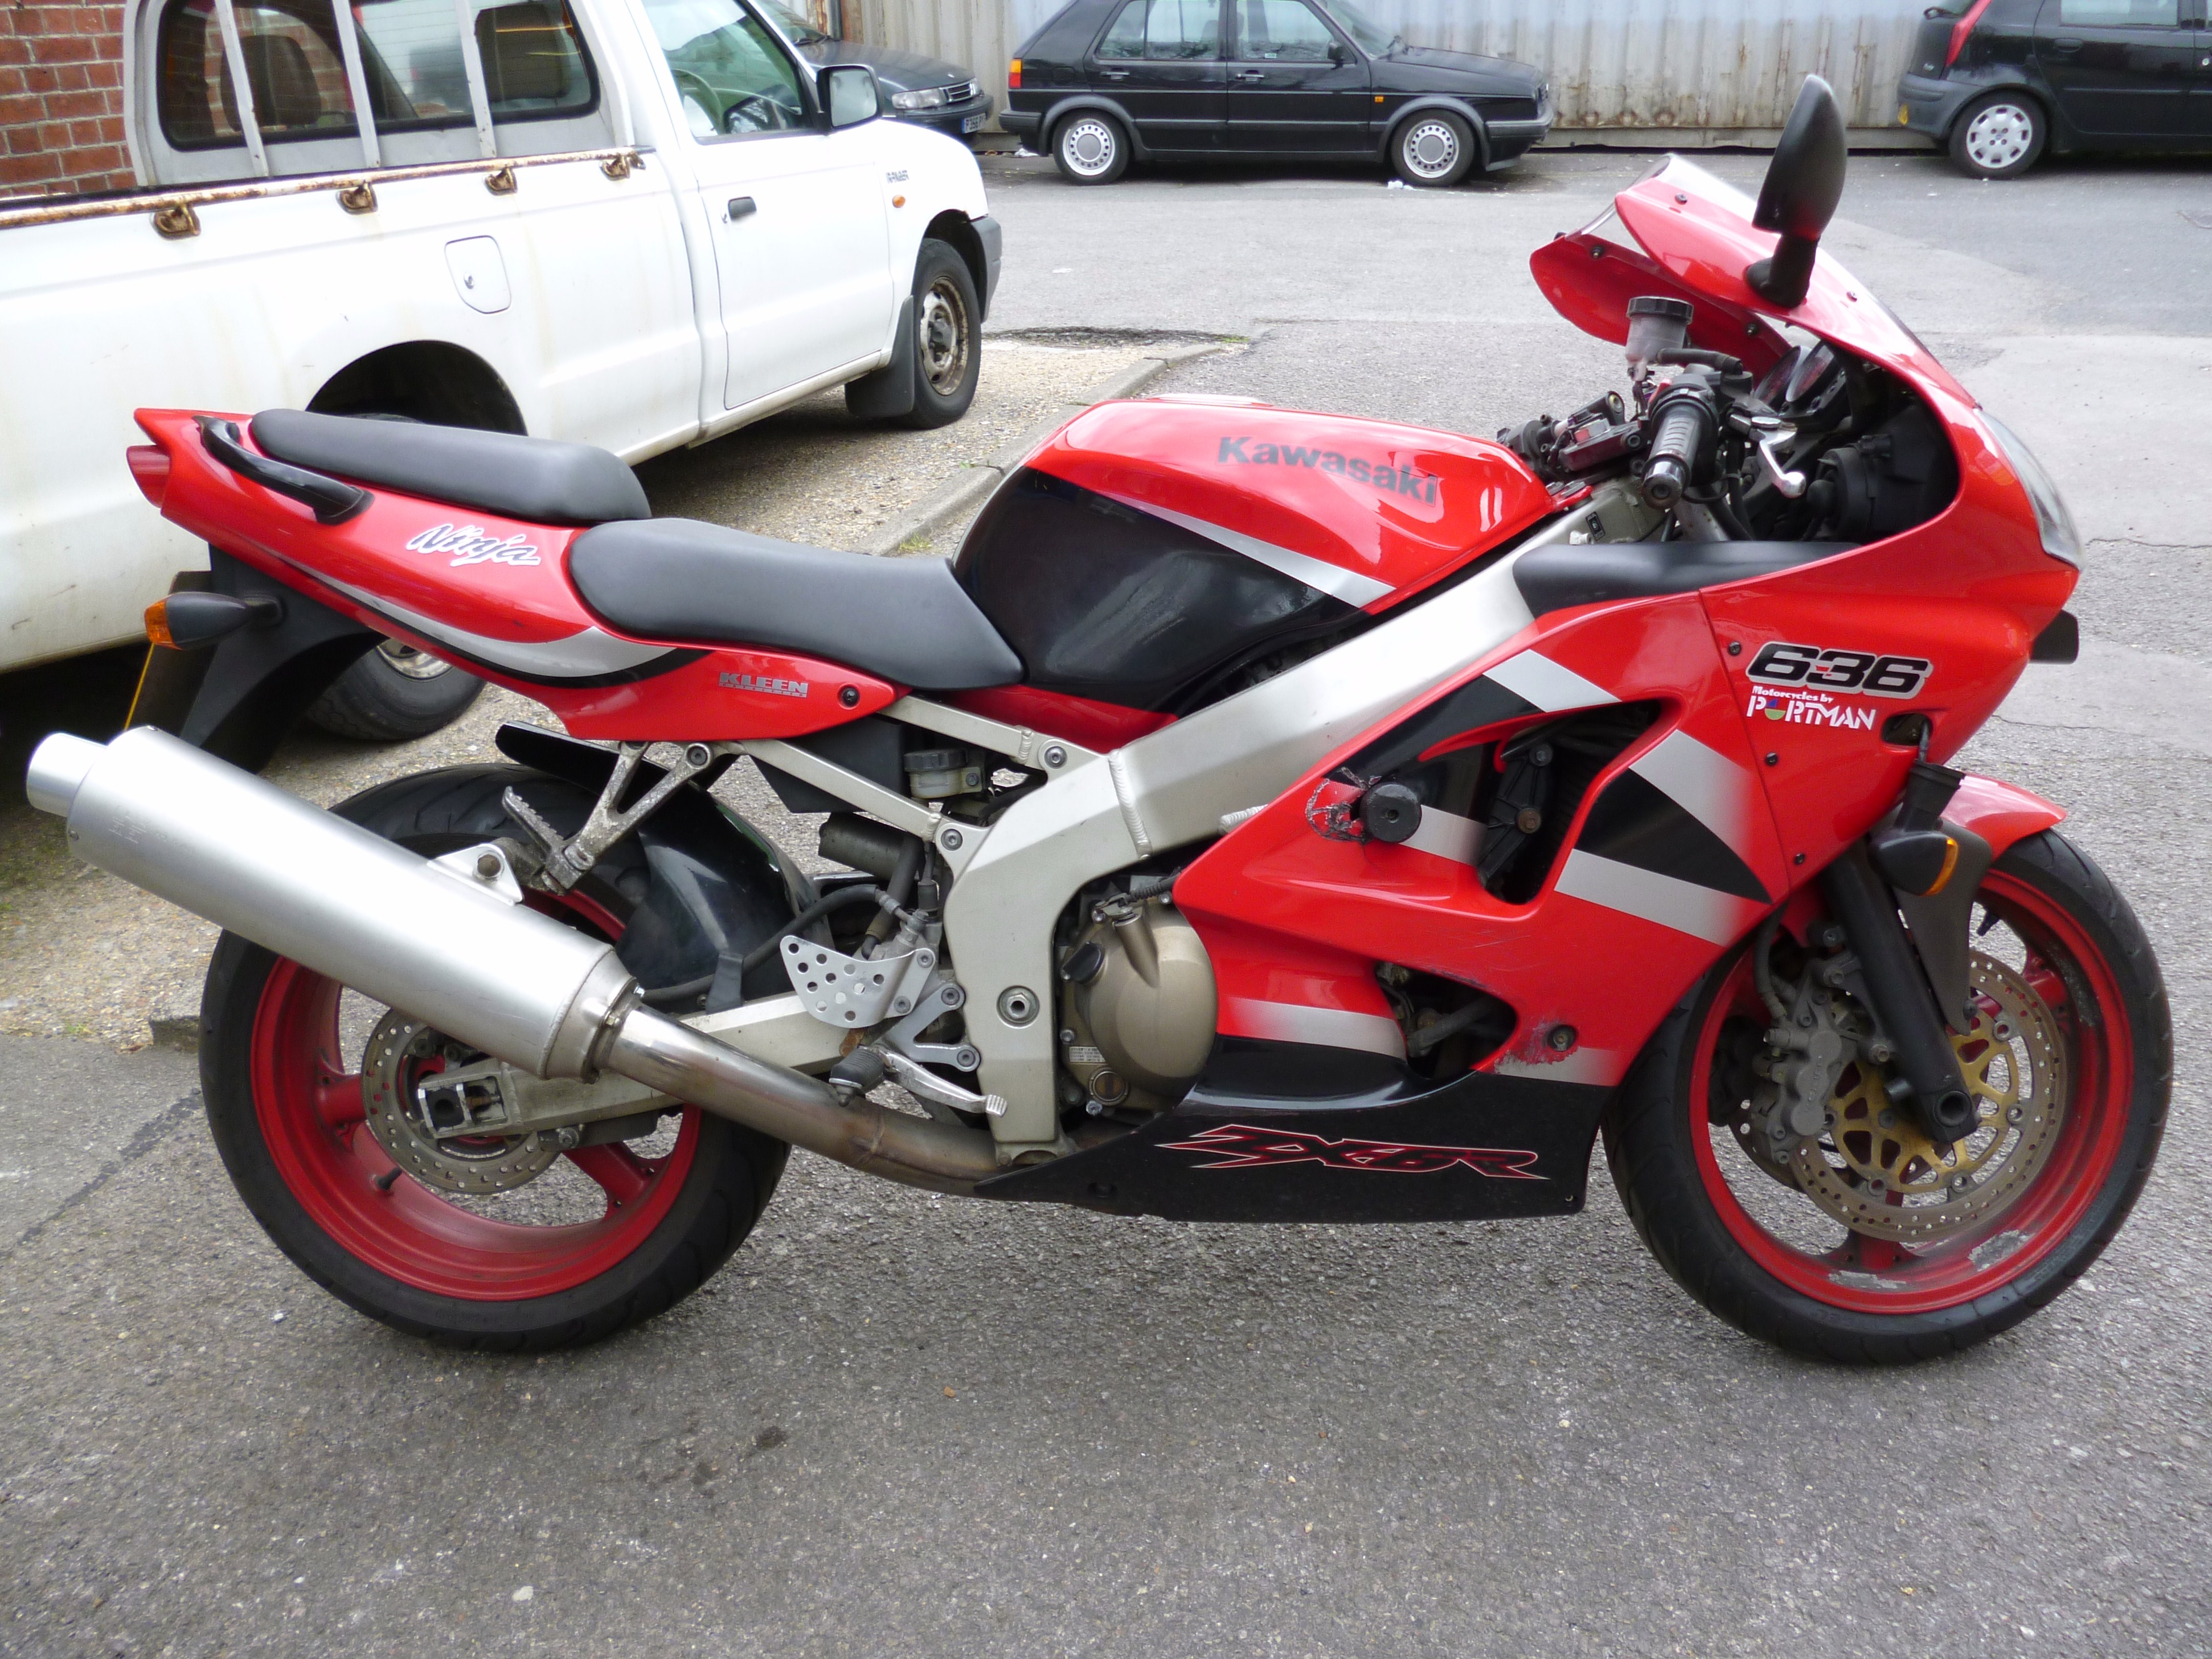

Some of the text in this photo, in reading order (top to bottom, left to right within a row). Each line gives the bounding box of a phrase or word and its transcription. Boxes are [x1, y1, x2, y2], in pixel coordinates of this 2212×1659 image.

[1217, 436, 1438, 505] Kawasaki
[406, 523, 542, 567] Ninja
[719, 672, 809, 694] KLEEN
[1747, 642, 1932, 698] 636
[1747, 695, 1876, 731] PORTMAN
[1752, 685, 1834, 704] Motorcycles by
